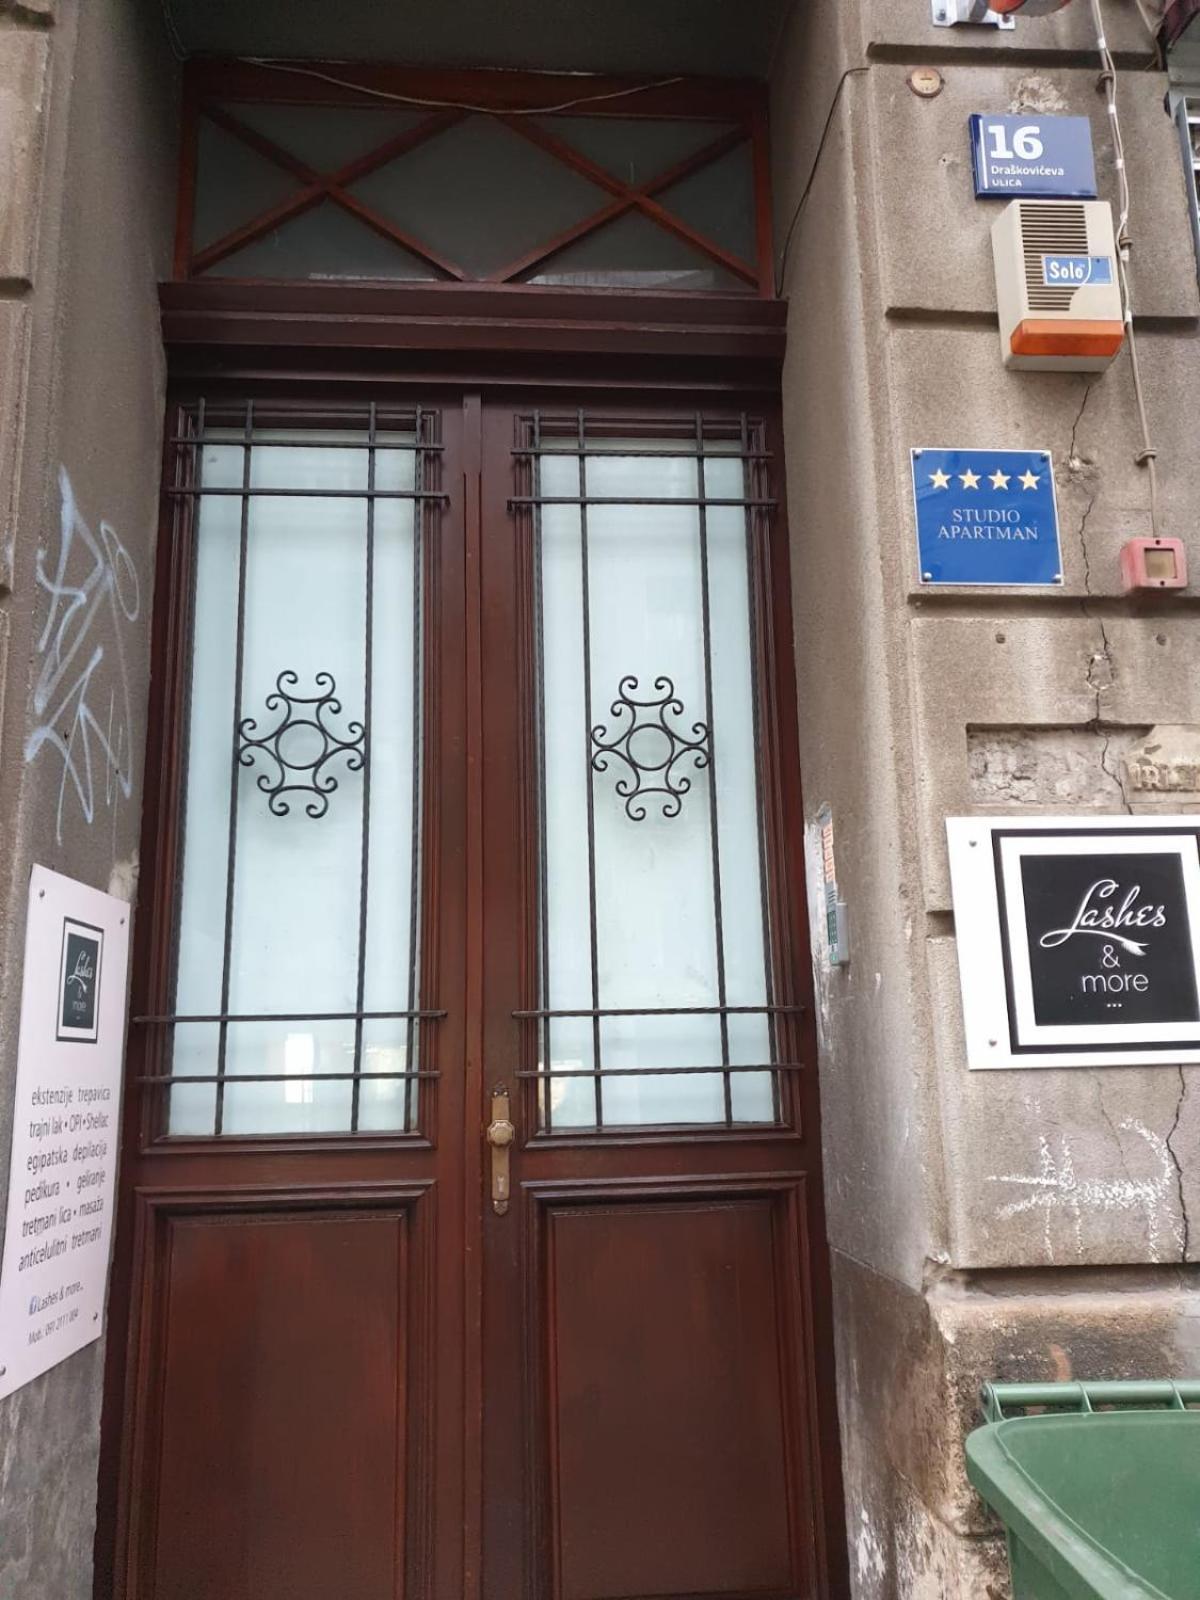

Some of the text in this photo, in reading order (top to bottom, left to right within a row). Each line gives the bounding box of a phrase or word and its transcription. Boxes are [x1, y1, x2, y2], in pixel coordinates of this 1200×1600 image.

[988, 125, 1043, 160] 16
[991, 164, 1064, 176] Draškovićeva
[992, 178, 1022, 187] ULICA
[1049, 261, 1083, 279] Solo
[952, 508, 1021, 523] STUDIO
[938, 526, 1038, 541] APARTMAN
[1040, 879, 1166, 948] Lashes
[1102, 945, 1120, 968] &
[1081, 974, 1149, 993] more
[32, 1087, 111, 1107] ekstenzije trepavica
[27, 1145, 68, 1175] egipatska
[25, 1180, 60, 1209] pedikura
[22, 1208, 57, 1237] tretmani
